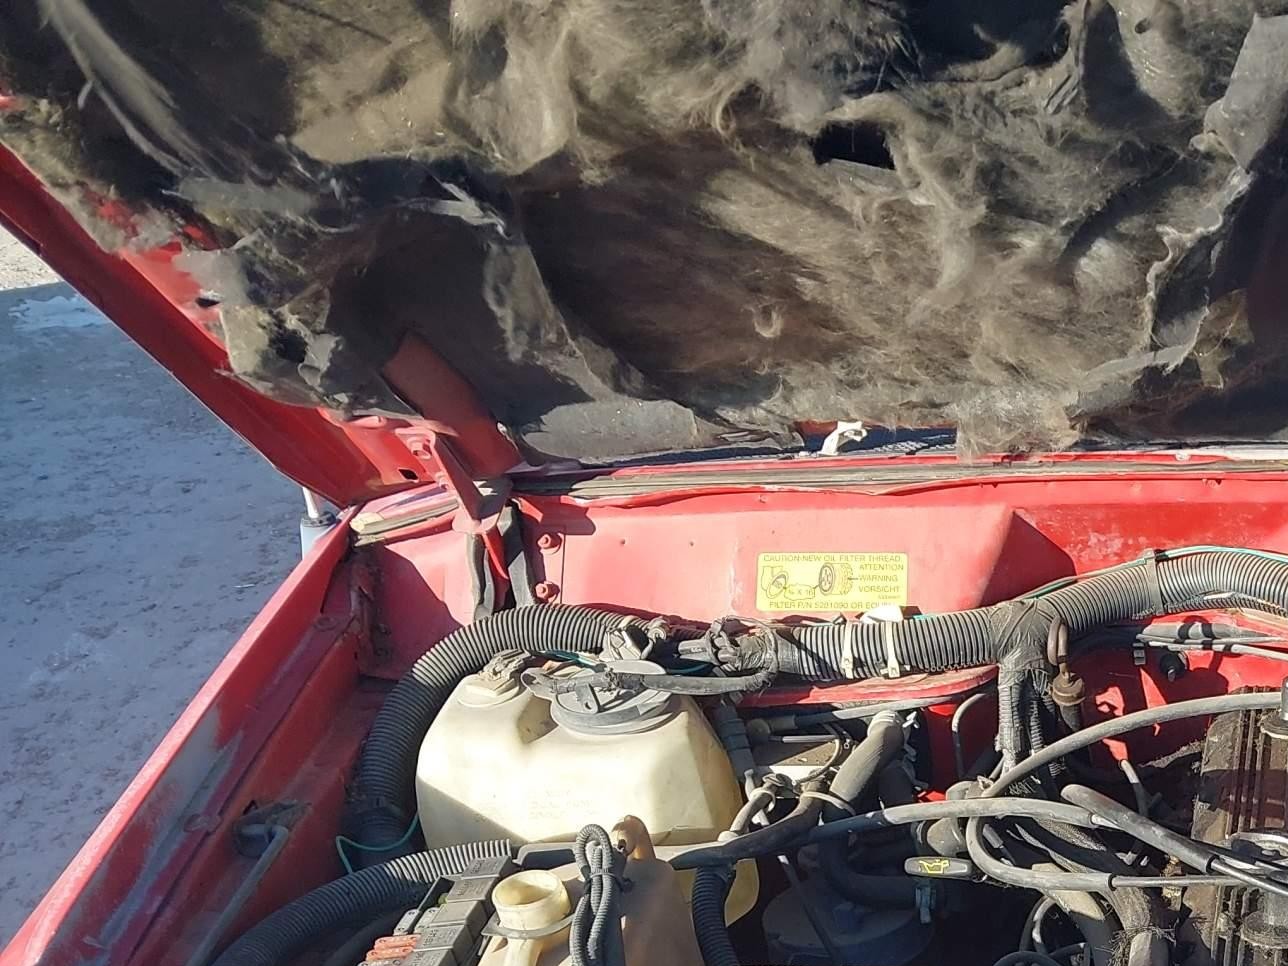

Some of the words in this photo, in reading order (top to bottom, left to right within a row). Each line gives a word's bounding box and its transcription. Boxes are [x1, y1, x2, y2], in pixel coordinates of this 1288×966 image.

[859, 563, 904, 571] ATTENTION
[859, 574, 898, 582] WARNING
[858, 585, 900, 593] VORSICHT
[769, 601, 796, 609] FILTER
